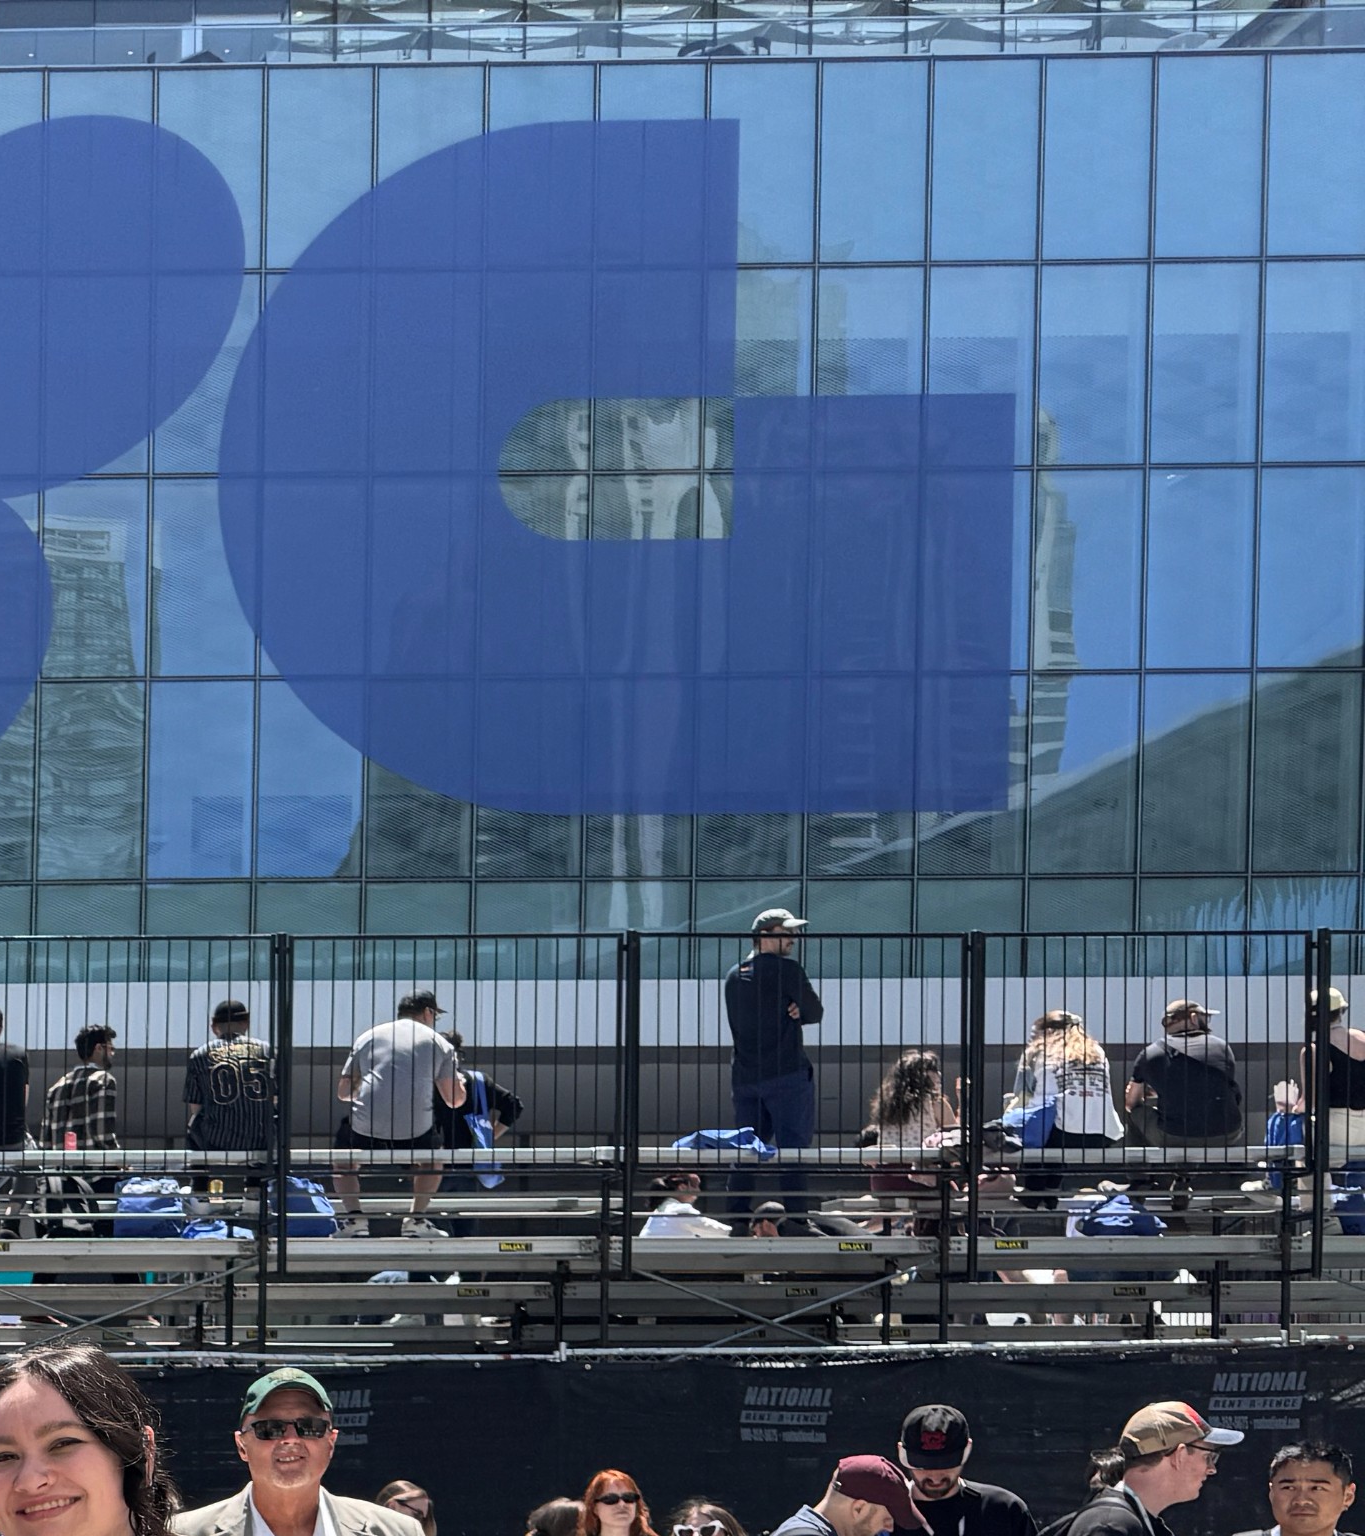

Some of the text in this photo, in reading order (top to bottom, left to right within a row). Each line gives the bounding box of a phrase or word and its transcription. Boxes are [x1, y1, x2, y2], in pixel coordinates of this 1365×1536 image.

[210, 1060, 269, 1105] 05
[1213, 1371, 1308, 1391] NATIONAL
[744, 1386, 833, 1407] NATIONAL
